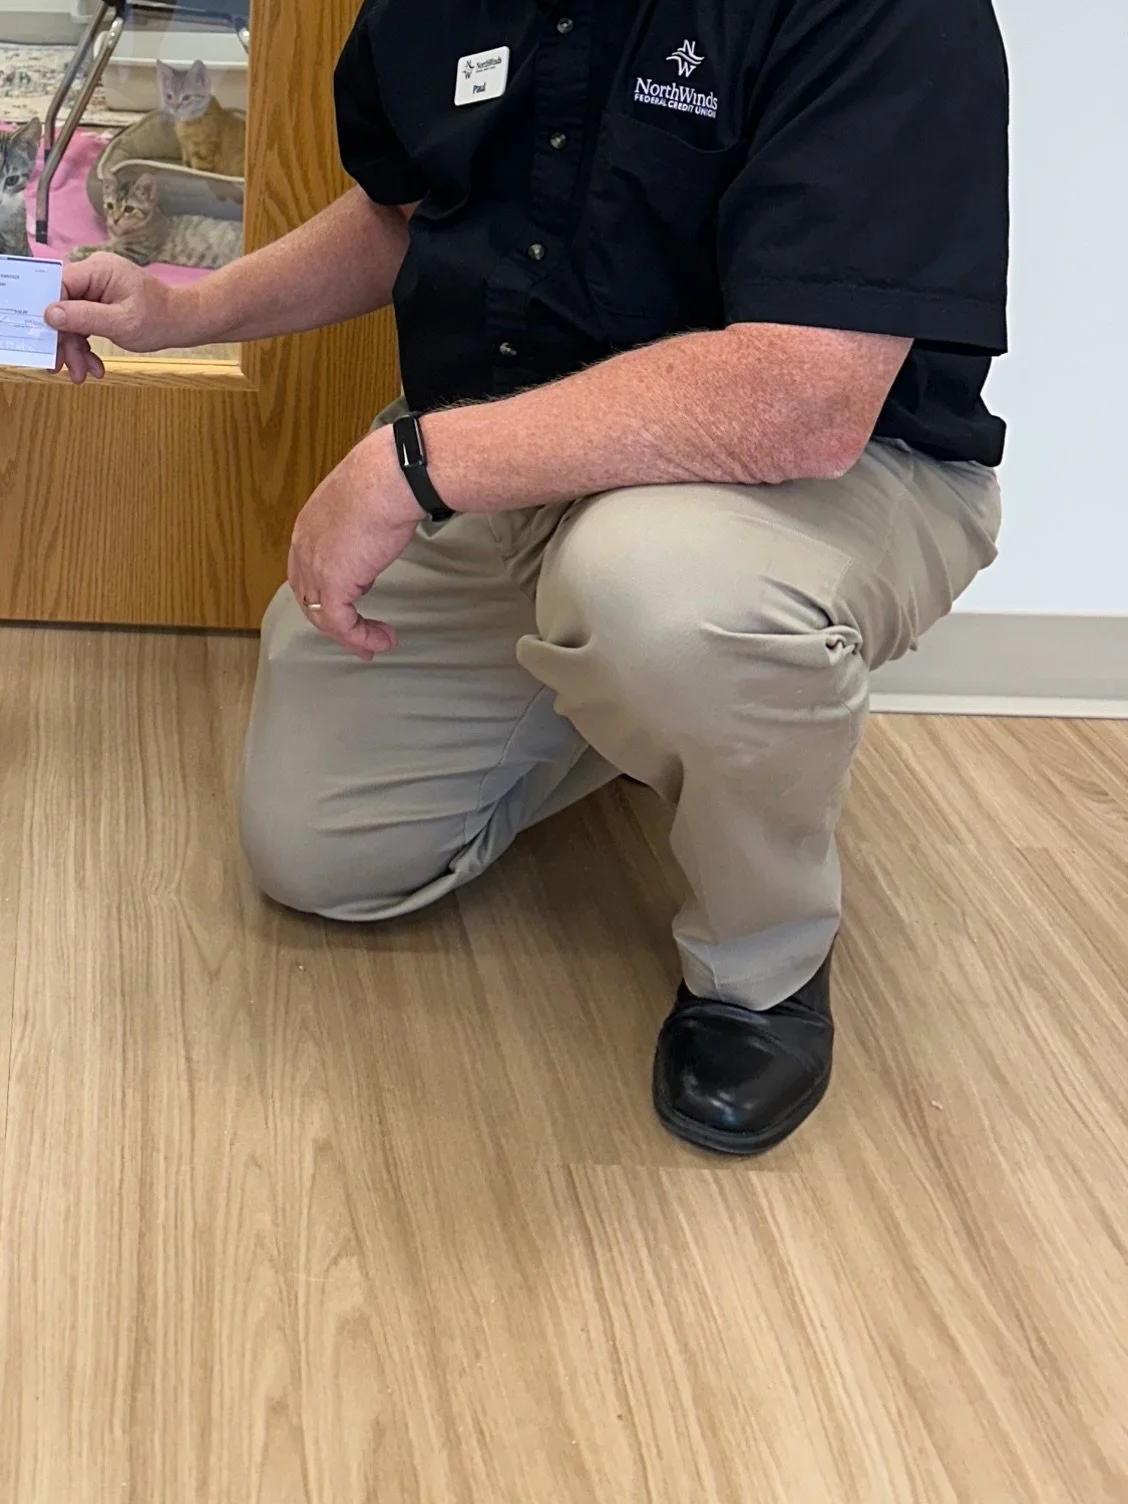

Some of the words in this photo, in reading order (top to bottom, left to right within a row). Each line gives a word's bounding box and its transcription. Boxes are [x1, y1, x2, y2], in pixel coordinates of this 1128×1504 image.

[634, 77, 718, 110] NorthWinds
[634, 93, 667, 107] FEDERAL
[667, 100, 694, 113] CREDIT
